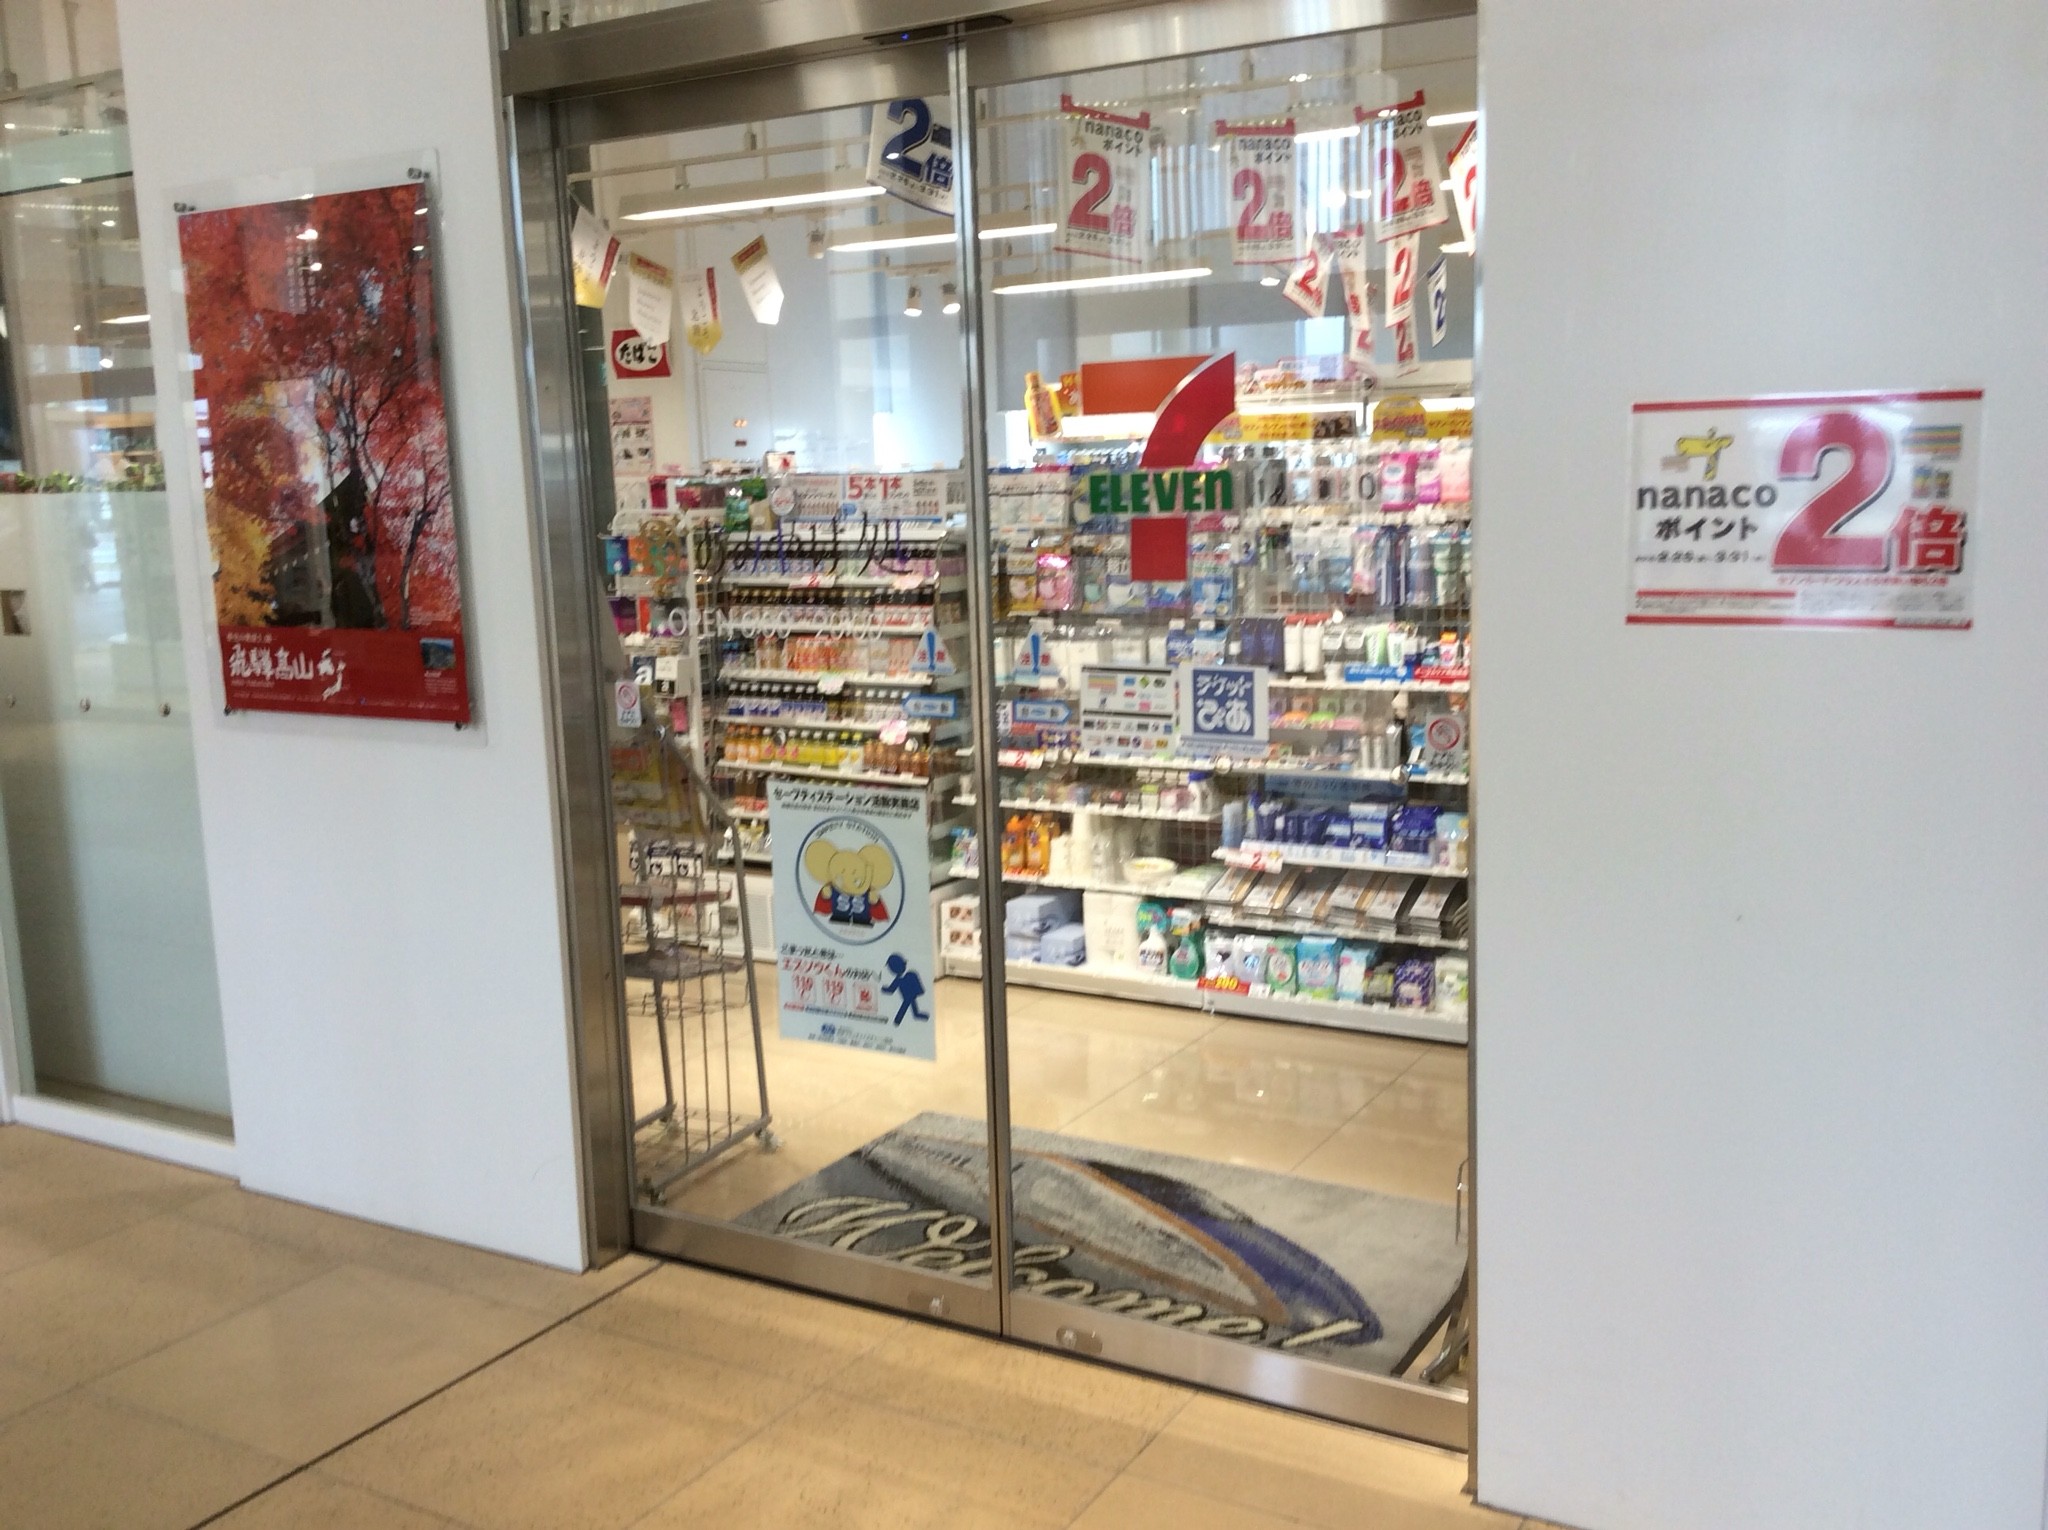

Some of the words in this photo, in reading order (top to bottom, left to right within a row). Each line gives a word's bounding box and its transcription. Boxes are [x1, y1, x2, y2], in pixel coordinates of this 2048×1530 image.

[1085, 119, 1143, 144] nanaco
[1239, 138, 1291, 151] nanaco
[618, 341, 658, 365] たばこ
[1637, 482, 1779, 511] nanaco
[1655, 515, 1760, 543] ポイント
[228, 642, 315, 681] 飛騨高山
[1196, 697, 1252, 733] ぴあ
